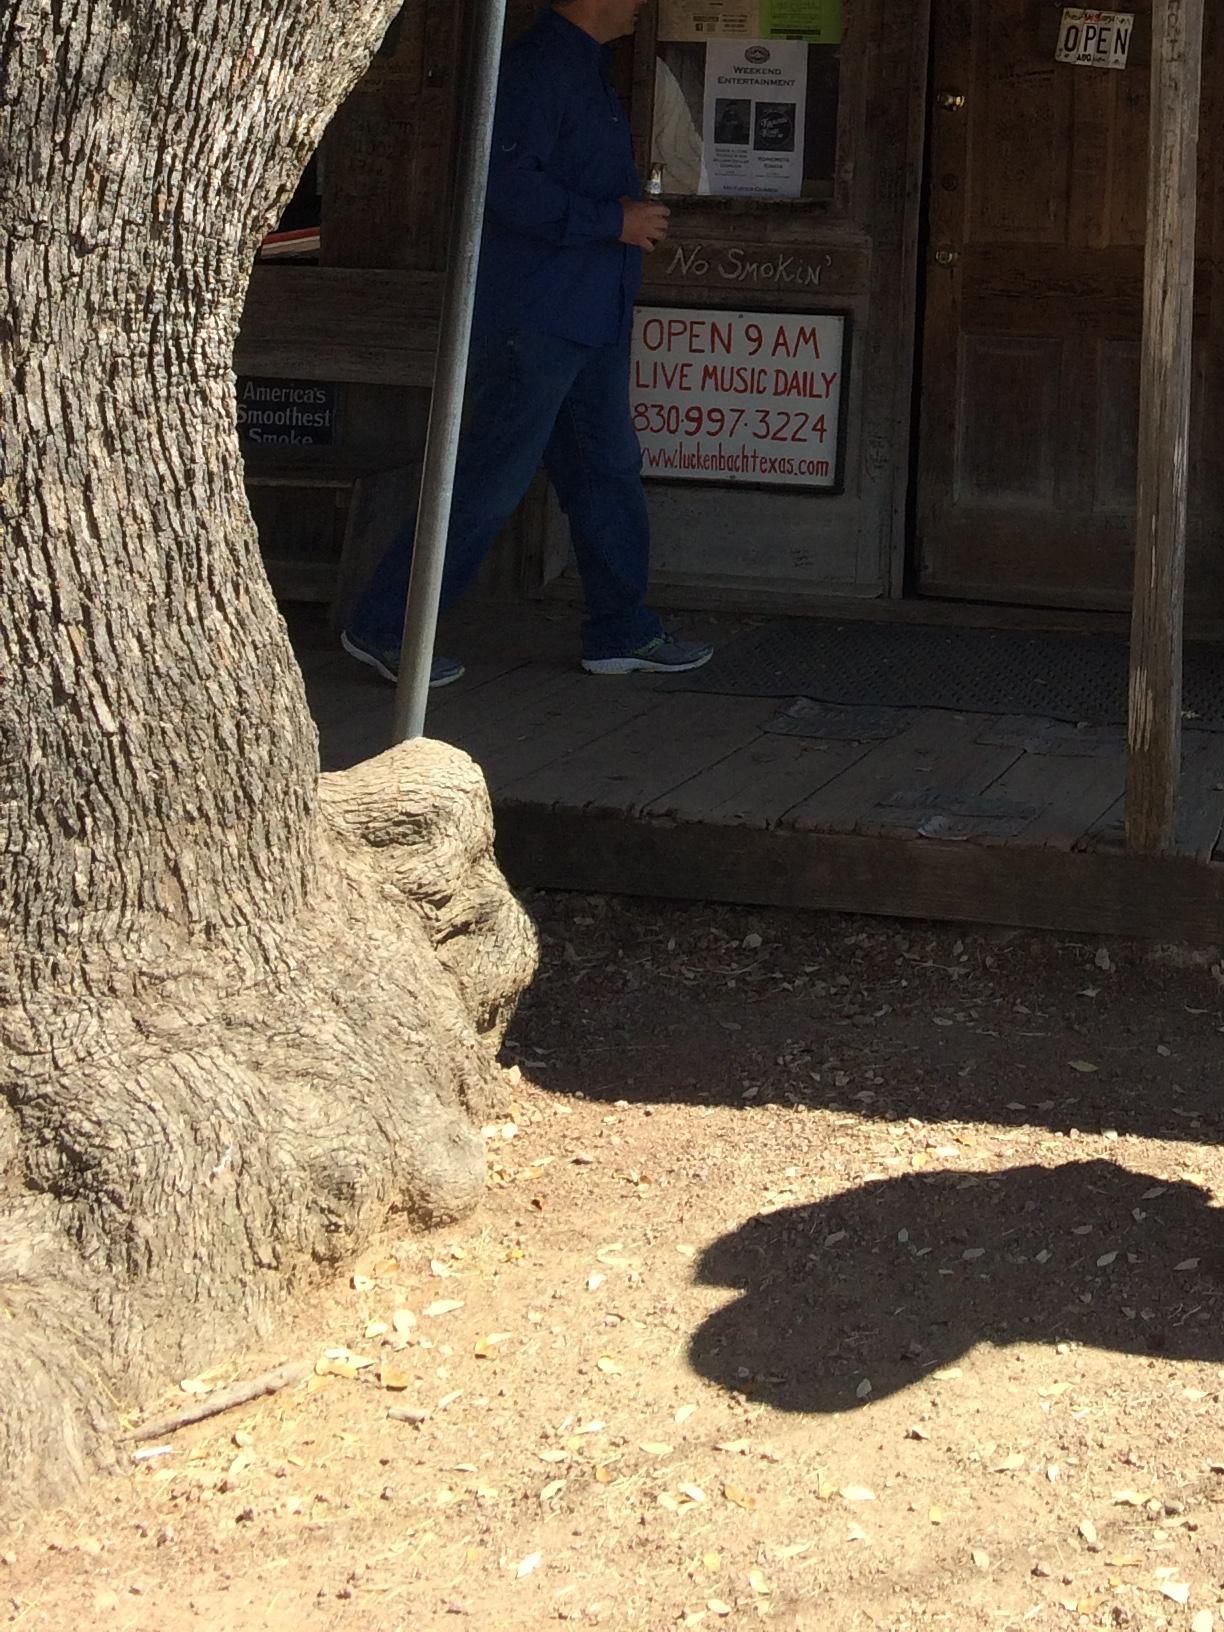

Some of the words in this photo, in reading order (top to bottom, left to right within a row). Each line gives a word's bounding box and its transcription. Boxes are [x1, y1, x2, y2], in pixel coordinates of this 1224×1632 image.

[1063, 24, 1129, 56] OPEN
[716, 75, 797, 87] ENTERTAINMENT
[732, 65, 783, 76] WEEKEND
[642, 318, 733, 355] OPEN
[770, 325, 821, 360] AM
[633, 359, 694, 391] LIVE
[700, 363, 768, 394] MUSIC
[772, 368, 838, 399] DAILY
[243, 380, 327, 404] America's
[237, 403, 331, 427] Smoothest
